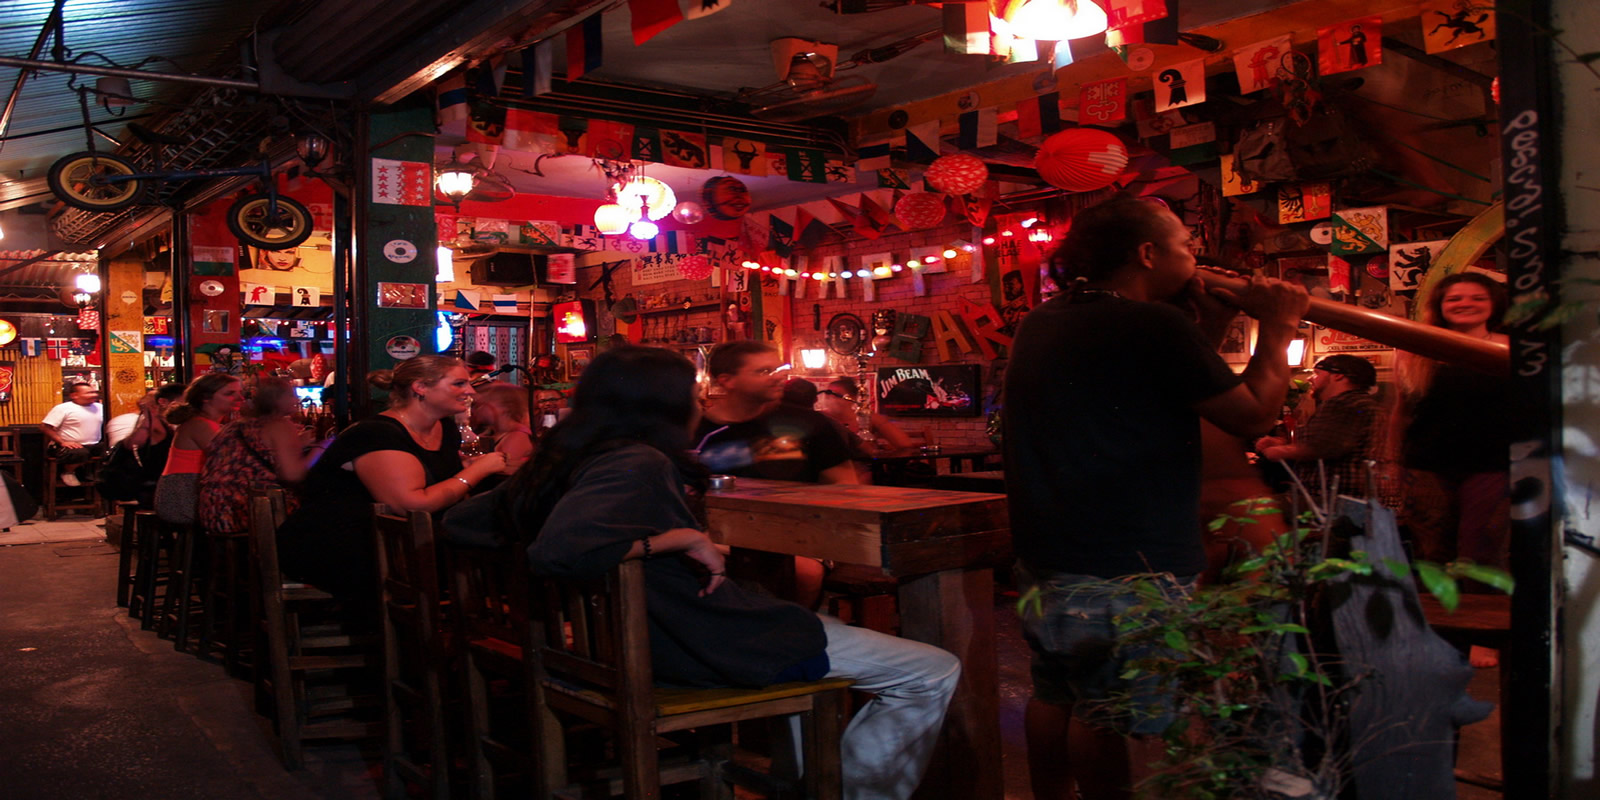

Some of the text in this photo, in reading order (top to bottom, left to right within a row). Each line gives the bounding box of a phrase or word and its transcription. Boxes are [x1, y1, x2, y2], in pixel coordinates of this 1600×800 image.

[888, 297, 1013, 363] BAR
[880, 367, 932, 399] JIM BEAM
